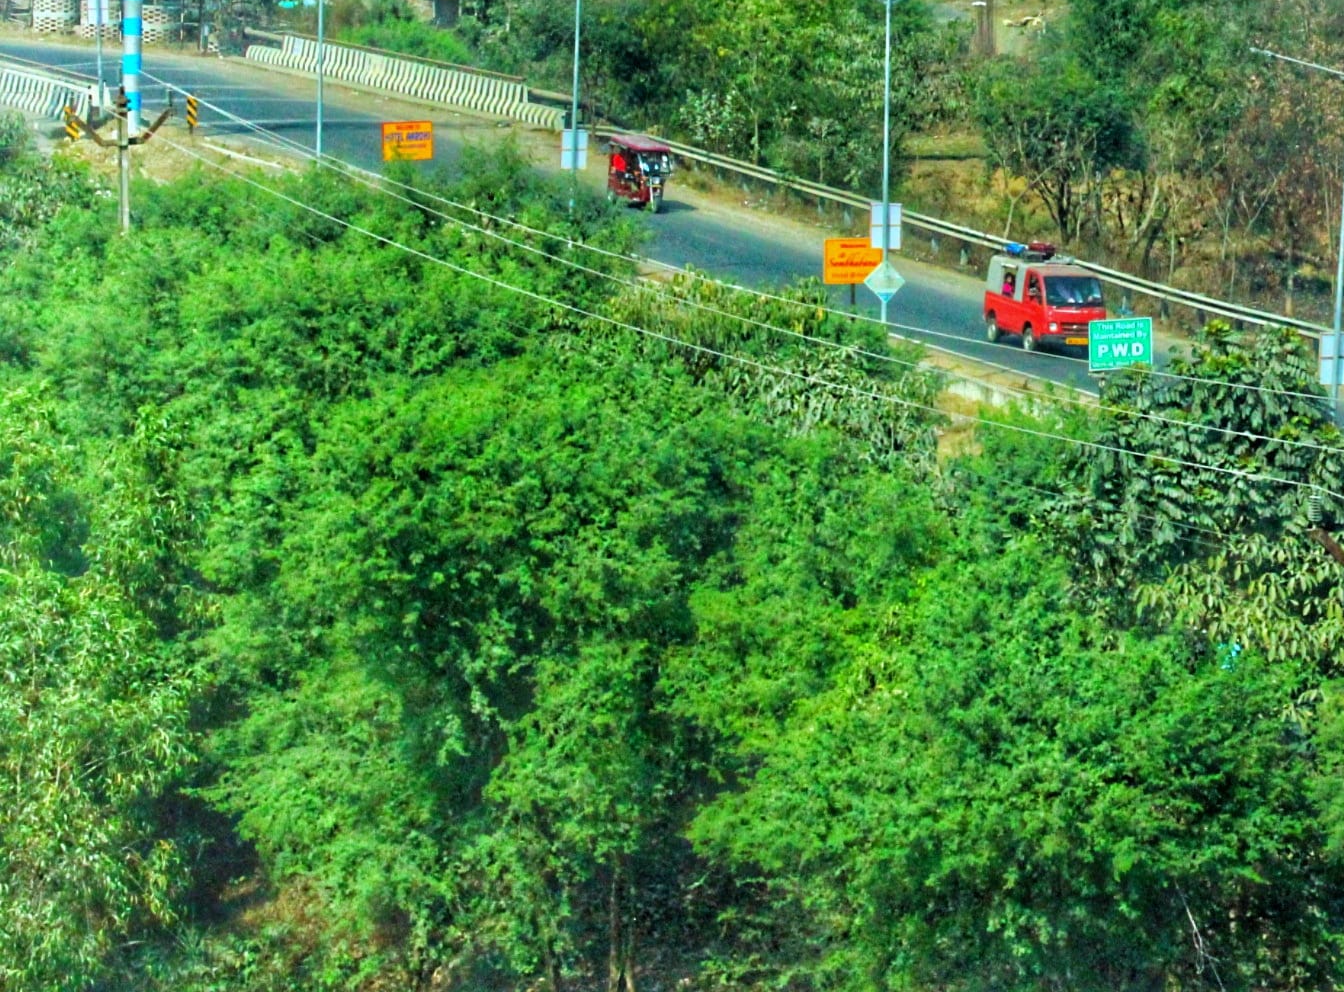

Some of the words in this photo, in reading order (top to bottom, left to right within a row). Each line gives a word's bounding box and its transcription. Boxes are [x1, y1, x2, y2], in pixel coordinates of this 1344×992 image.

[1097, 322, 1113, 331] This
[1115, 321, 1135, 330] Road
[1093, 331, 1135, 340] Maintained
